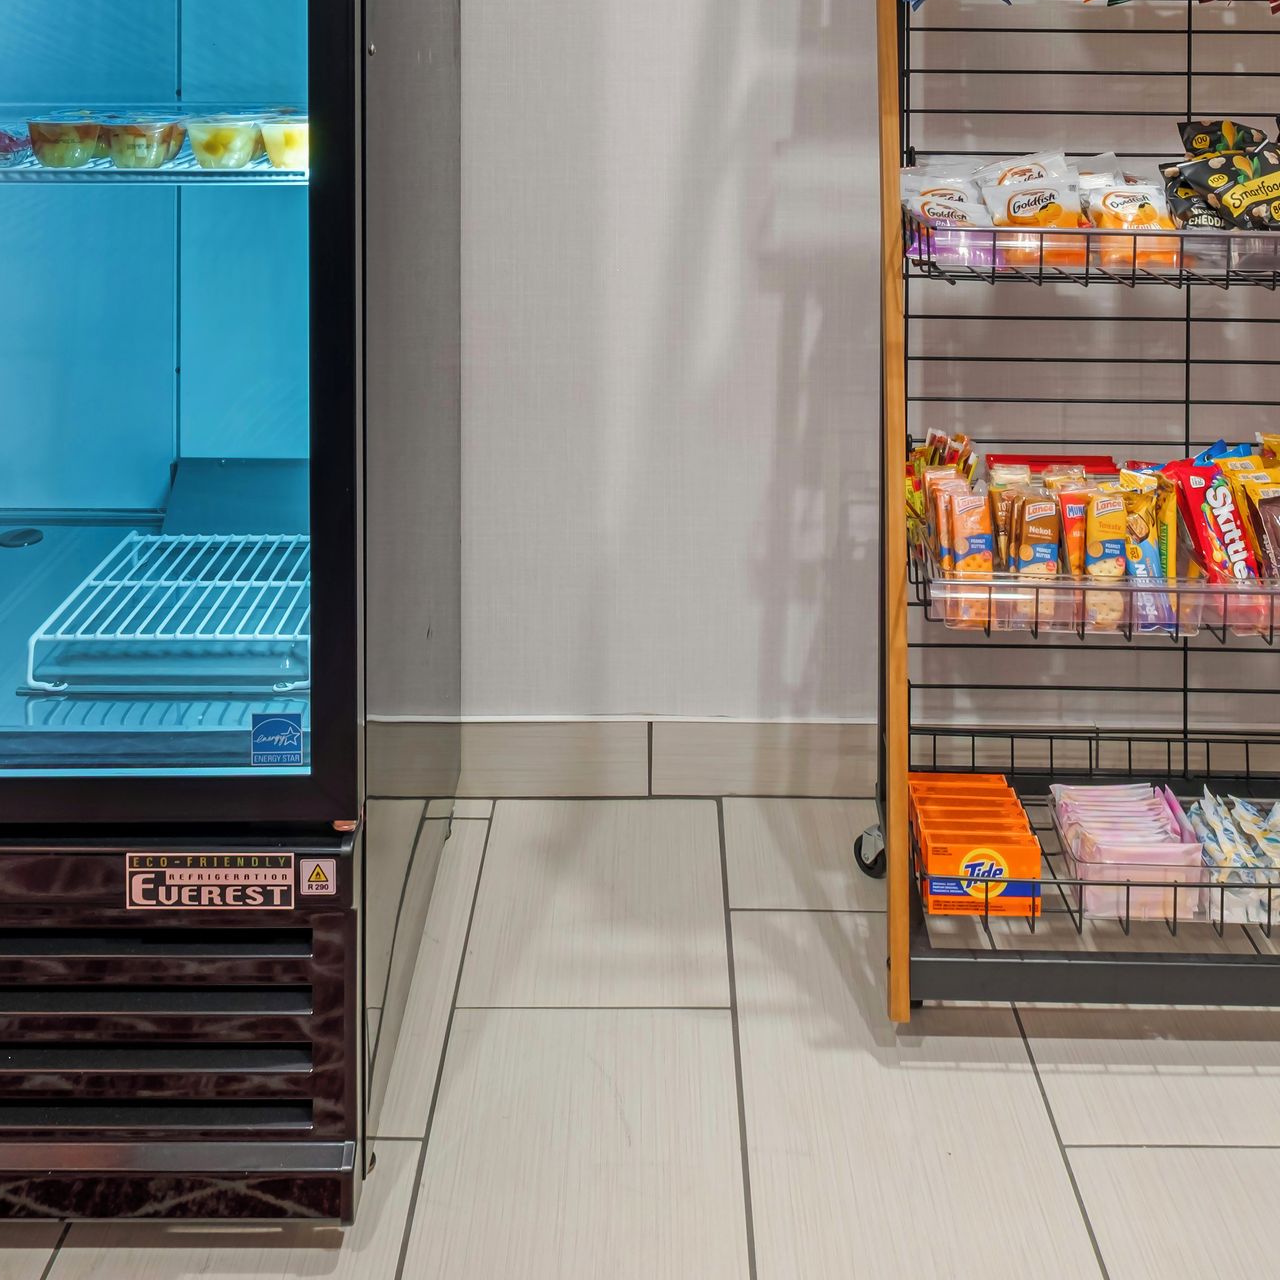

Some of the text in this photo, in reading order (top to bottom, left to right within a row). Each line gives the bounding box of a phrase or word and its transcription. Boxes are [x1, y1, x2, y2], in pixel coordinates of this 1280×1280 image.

[1194, 135, 1208, 145] 100
[1209, 174, 1225, 184] 100
[1013, 192, 1056, 214] Goldfish
[927, 207, 968, 220] Goldfish
[1028, 504, 1055, 517] Lance
[1095, 499, 1124, 512] Lance
[254, 754, 301, 763] ENERGY STAR
[132, 856, 287, 868] ECO-FRIENDLY
[169, 873, 289, 882] REFRIGERATION
[963, 860, 1005, 890] Tide
[131, 872, 288, 906] EVEREST
[315, 883, 329, 891] 290
